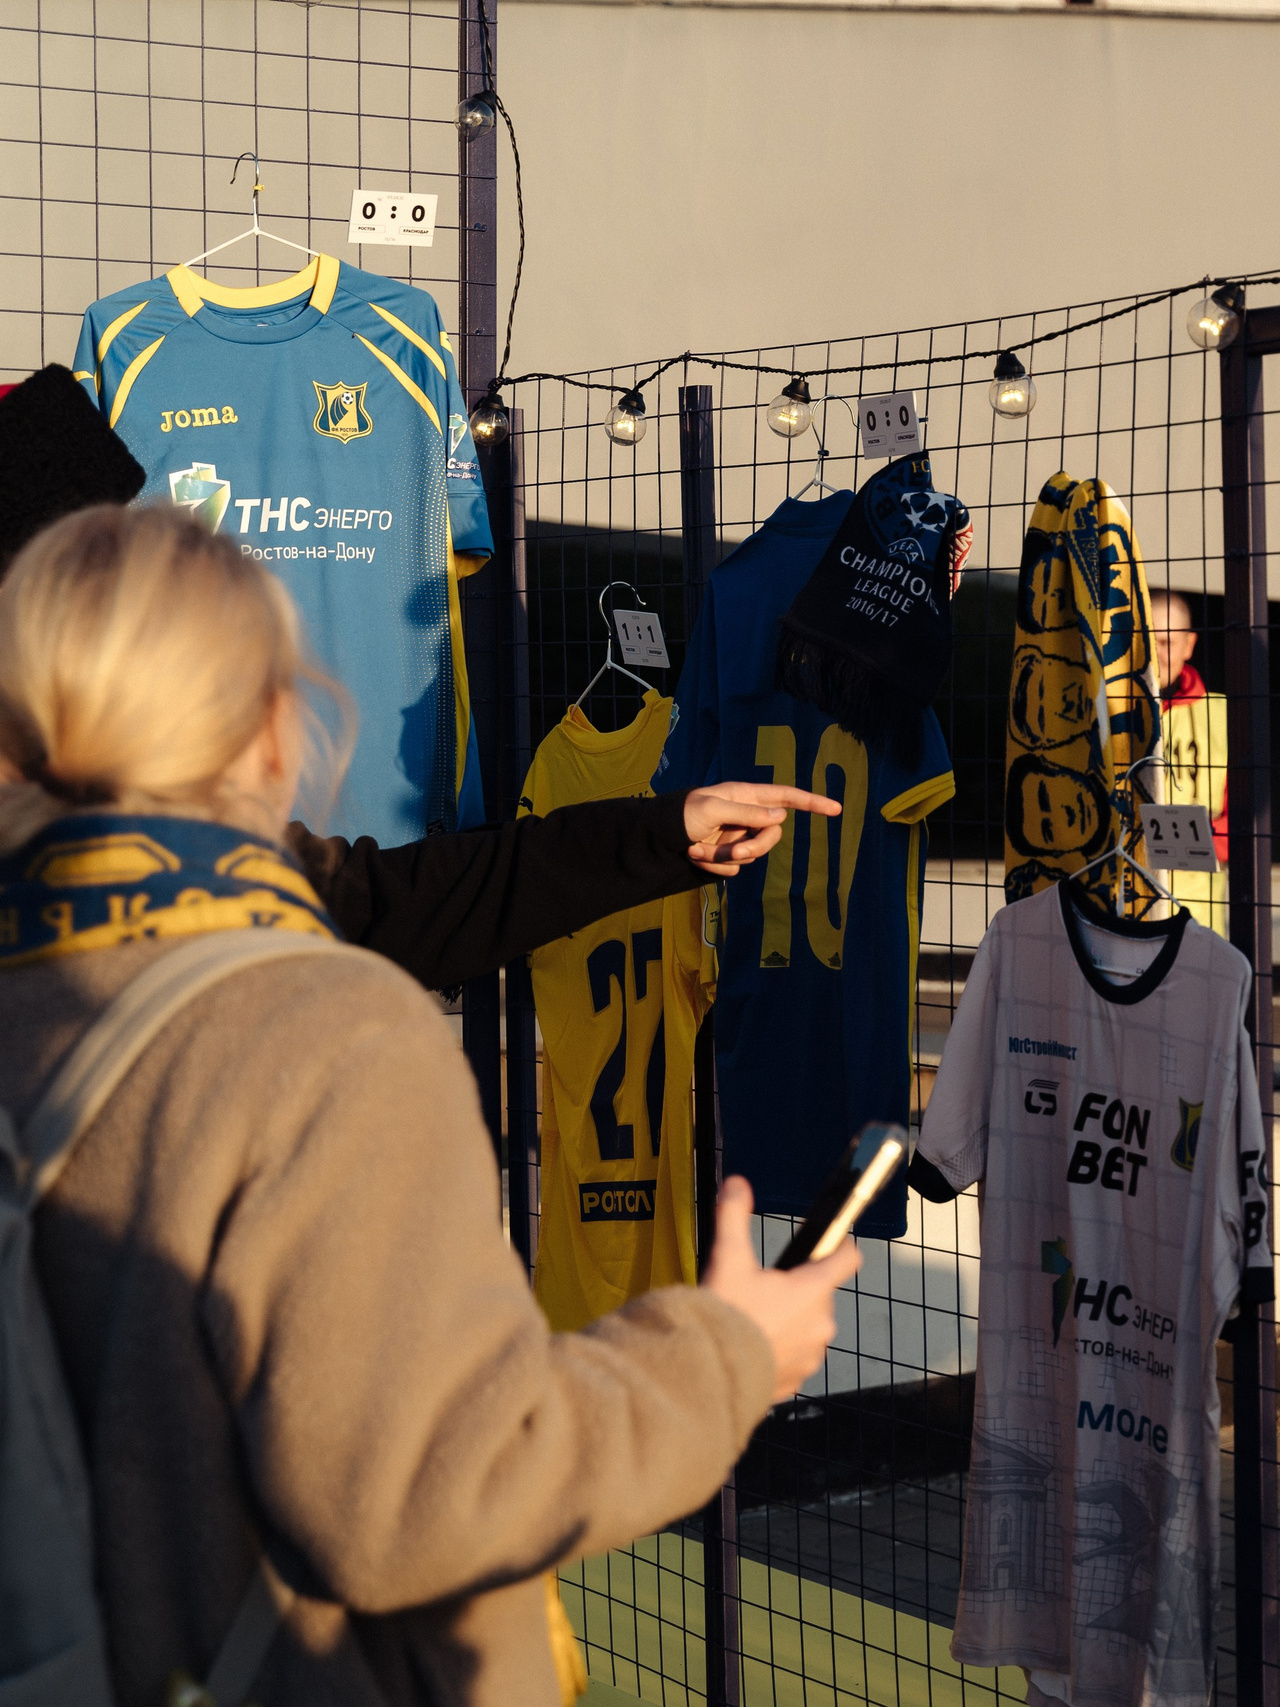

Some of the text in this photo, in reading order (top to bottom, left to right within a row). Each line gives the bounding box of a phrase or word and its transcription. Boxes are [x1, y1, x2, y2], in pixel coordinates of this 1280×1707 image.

[362, 202, 376, 220] 0
[411, 205, 425, 223] 0
[866, 411, 877, 431] 0
[899, 405, 909, 427] 0
[234, 496, 393, 534] ТНС ЭНЕРГО
[845, 596, 899, 628] 2016/17
[853, 577, 915, 614] LEAGUE
[754, 723, 869, 971] 10
[1149, 818, 1163, 840] 2
[1188, 819, 1200, 842] 1
[1073, 1092, 1151, 1150] FON
[1066, 1140, 1148, 1197] BET
[1073, 1277, 1133, 1326] НС
